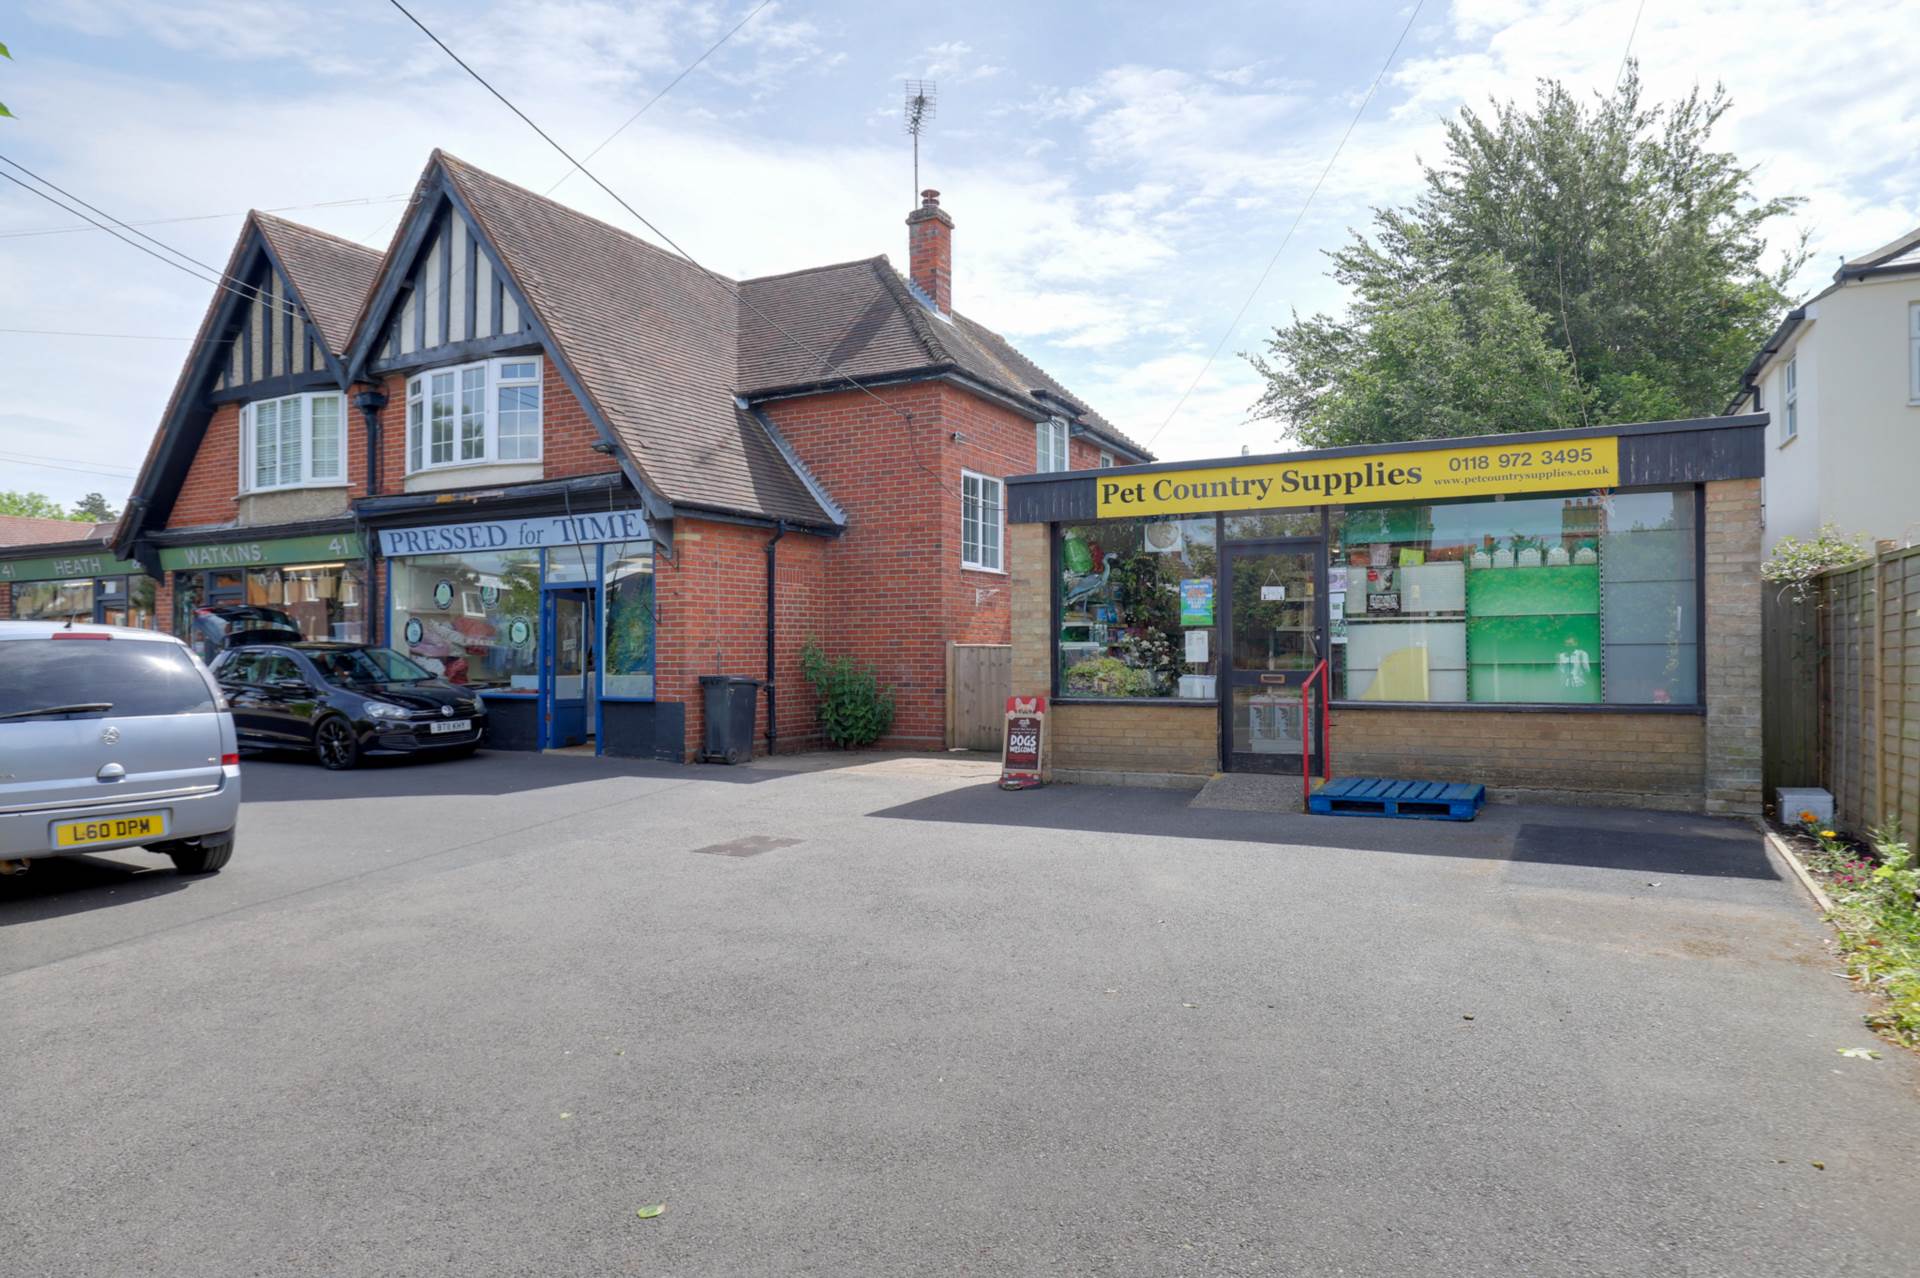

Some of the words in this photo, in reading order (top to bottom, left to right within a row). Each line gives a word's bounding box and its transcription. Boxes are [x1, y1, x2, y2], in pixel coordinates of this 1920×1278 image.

[1448, 456, 1490, 472] 0118
[1498, 452, 1533, 468] 972
[1540, 447, 1593, 465] 3495
[1102, 483, 1146, 505] Pet
[1153, 476, 1273, 501] Country
[1281, 462, 1423, 497] Supplies
[1433, 465, 1610, 486] www.petcountrysupplies.co.uk
[388, 525, 508, 553] PRESSED
[519, 522, 544, 546] for
[552, 512, 643, 542] TIME
[327, 537, 349, 556] 41
[1, 564, 16, 579] 41
[54, 558, 102, 576] HEATH
[1009, 745, 1037, 754] WELCOME
[1010, 735, 1037, 746] DOGS
[73, 824, 110, 841] L60
[116, 818, 150, 836] DPM
